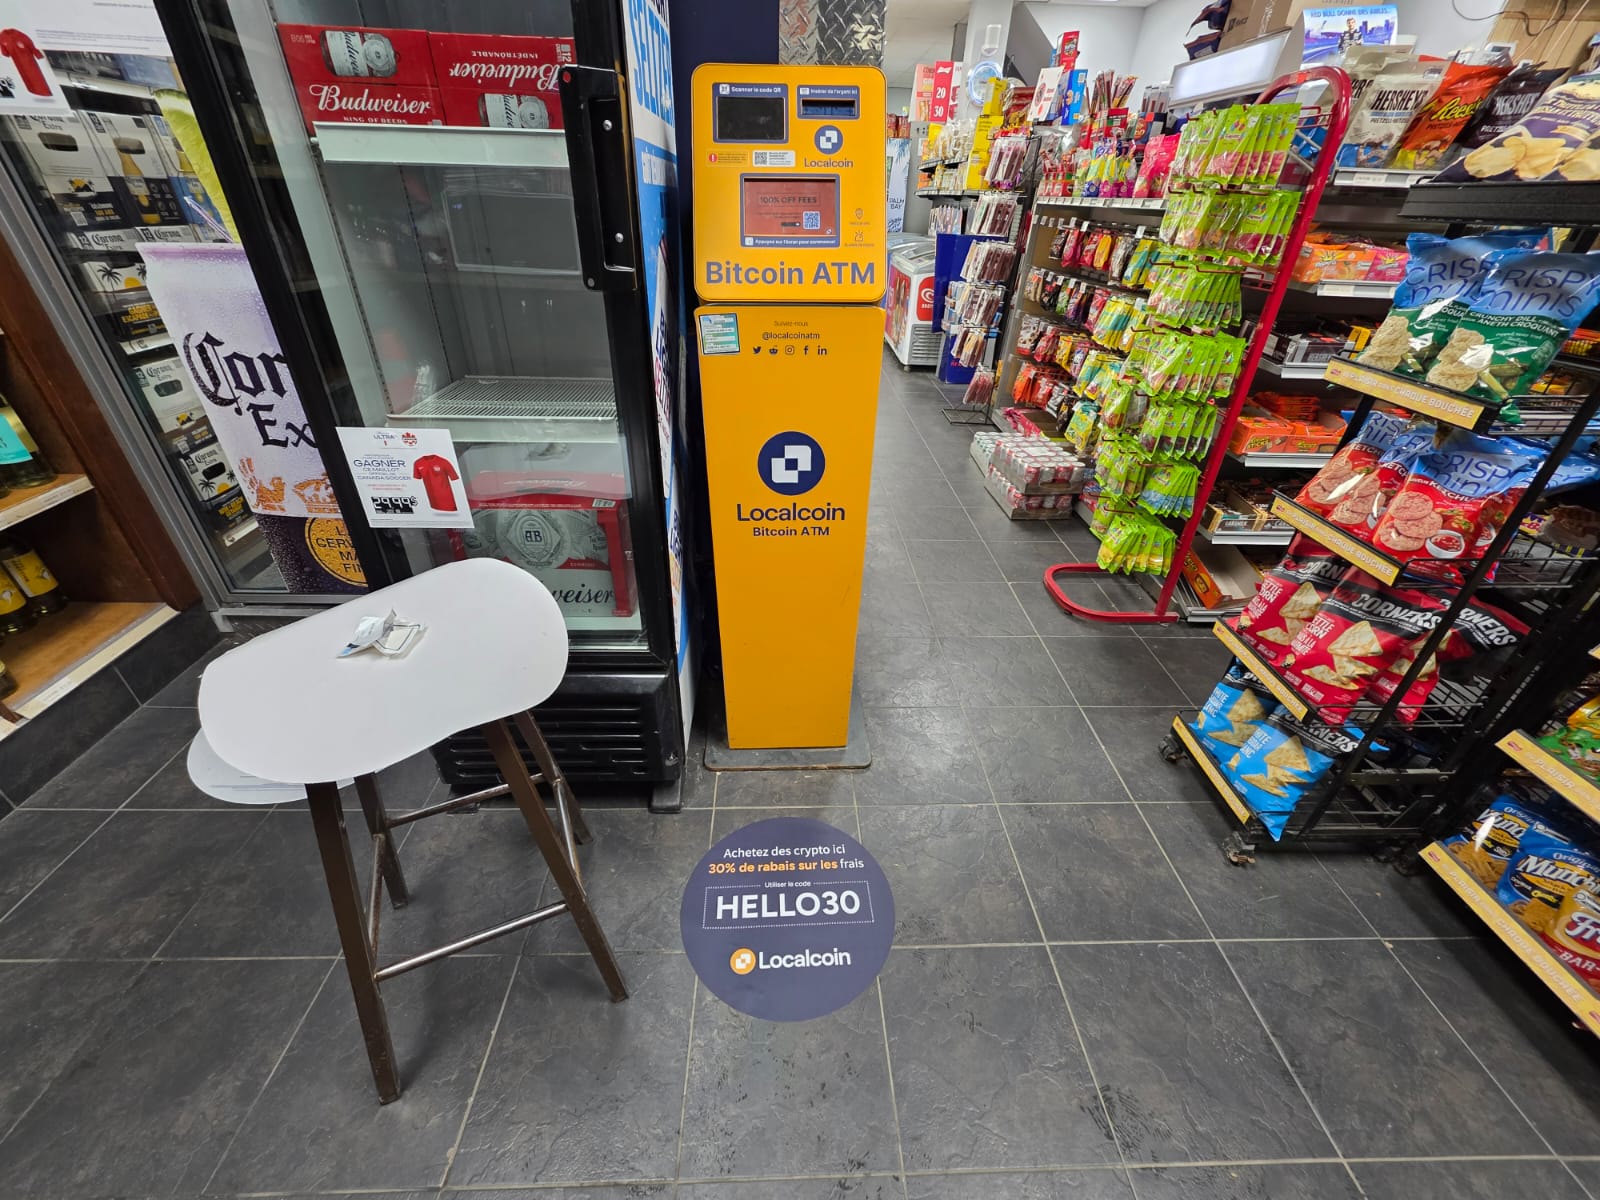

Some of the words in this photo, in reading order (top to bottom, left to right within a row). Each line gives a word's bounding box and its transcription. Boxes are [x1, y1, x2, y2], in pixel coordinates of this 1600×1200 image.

[449, 63, 561, 91] Budweiser
[309, 84, 431, 114] Budweiser
[936, 86, 946, 99] 20
[933, 105, 944, 117] 30
[804, 158, 854, 168] Localcoin
[798, 196, 817, 204] FEES
[91, 232, 124, 245] Corona
[706, 261, 804, 285] Bitcoin
[812, 262, 875, 285] ATM
[1469, 312, 1514, 322] CRUNCHY
[1477, 318, 1509, 328] ANETH
[1510, 321, 1560, 338] CROQUANT
[762, 332, 821, 341] @localcoinatm
[353, 459, 406, 468] GAGNER
[737, 503, 845, 522] Localcoin
[752, 526, 797, 537] Bitcoin
[801, 526, 830, 537] ATM
[723, 846, 769, 858] Achetez
[771, 845, 792, 857] des
[793, 845, 830, 858] crypto
[832, 844, 846, 855] ici
[708, 863, 736, 874] 30%
[739, 862, 754, 873] de
[757, 861, 796, 872] rabais
[798, 861, 817, 871] sur
[820, 859, 838, 870] les
[839, 858, 865, 869] frais
[764, 881, 787, 889] Utiliser
[794, 880, 811, 888] code
[716, 890, 861, 920] HELLO30
[758, 947, 852, 969] Localcoin
